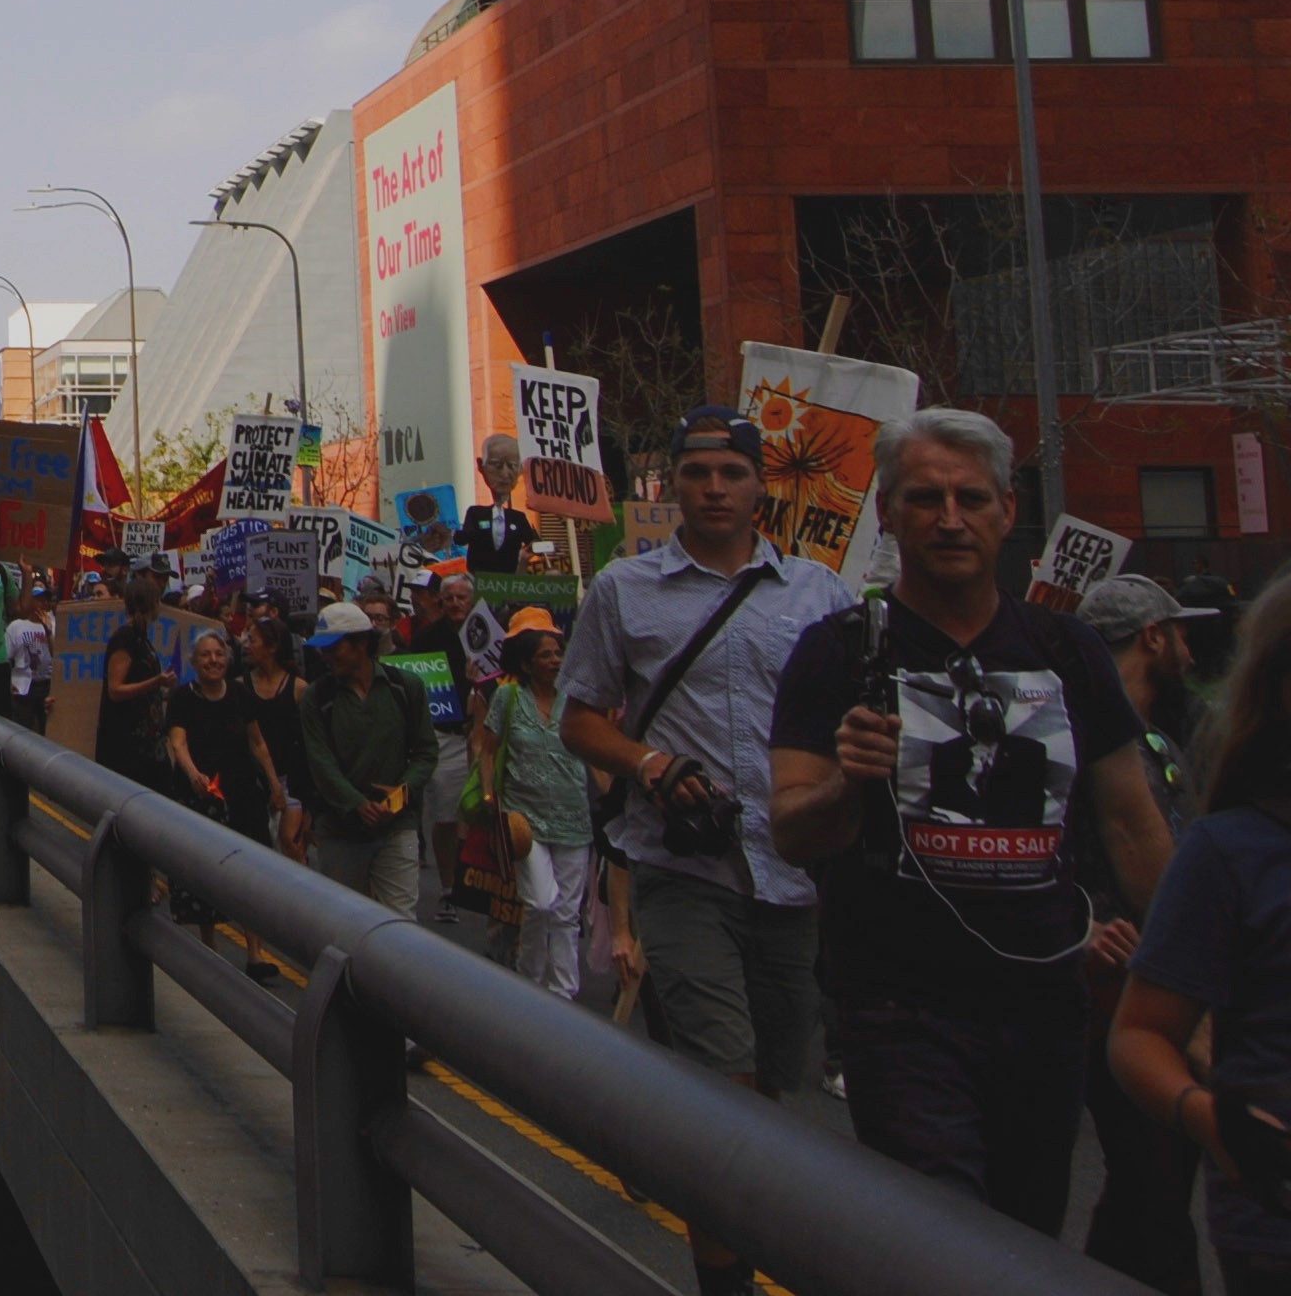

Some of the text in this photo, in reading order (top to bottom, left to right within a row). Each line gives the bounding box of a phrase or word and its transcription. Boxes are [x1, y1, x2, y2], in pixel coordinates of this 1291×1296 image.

[373, 128, 445, 211] The Art of
[376, 221, 441, 281] Our Time
[380, 304, 416, 339] On View
[520, 378, 586, 421] KEEP
[235, 424, 294, 446] PROTECT
[528, 417, 571, 442] IT IN
[11, 438, 71, 479] Free
[250, 444, 274, 452] OUR
[535, 438, 572, 461] THE
[232, 452, 292, 474] CLIMATE
[231, 472, 286, 489] WATER
[530, 456, 599, 506] GROUND
[226, 492, 285, 511] HEALTH
[0, 500, 47, 550] Fuel
[128, 522, 161, 533] KEEP IT
[350, 524, 379, 545] BUILD
[796, 505, 851, 550] FREE
[127, 534, 159, 543] IN THE
[267, 542, 309, 554] FLINT
[1056, 526, 1112, 565] KEEP
[261, 558, 309, 570] WATTS
[1053, 555, 1087, 577] IT IN
[266, 577, 296, 587] STOP
[477, 578, 576, 596] BAN FRACKING
[1054, 570, 1081, 590] THE
[1013, 687, 1054, 699] Bernie
[915, 832, 1057, 855] NOT FOR SALE
